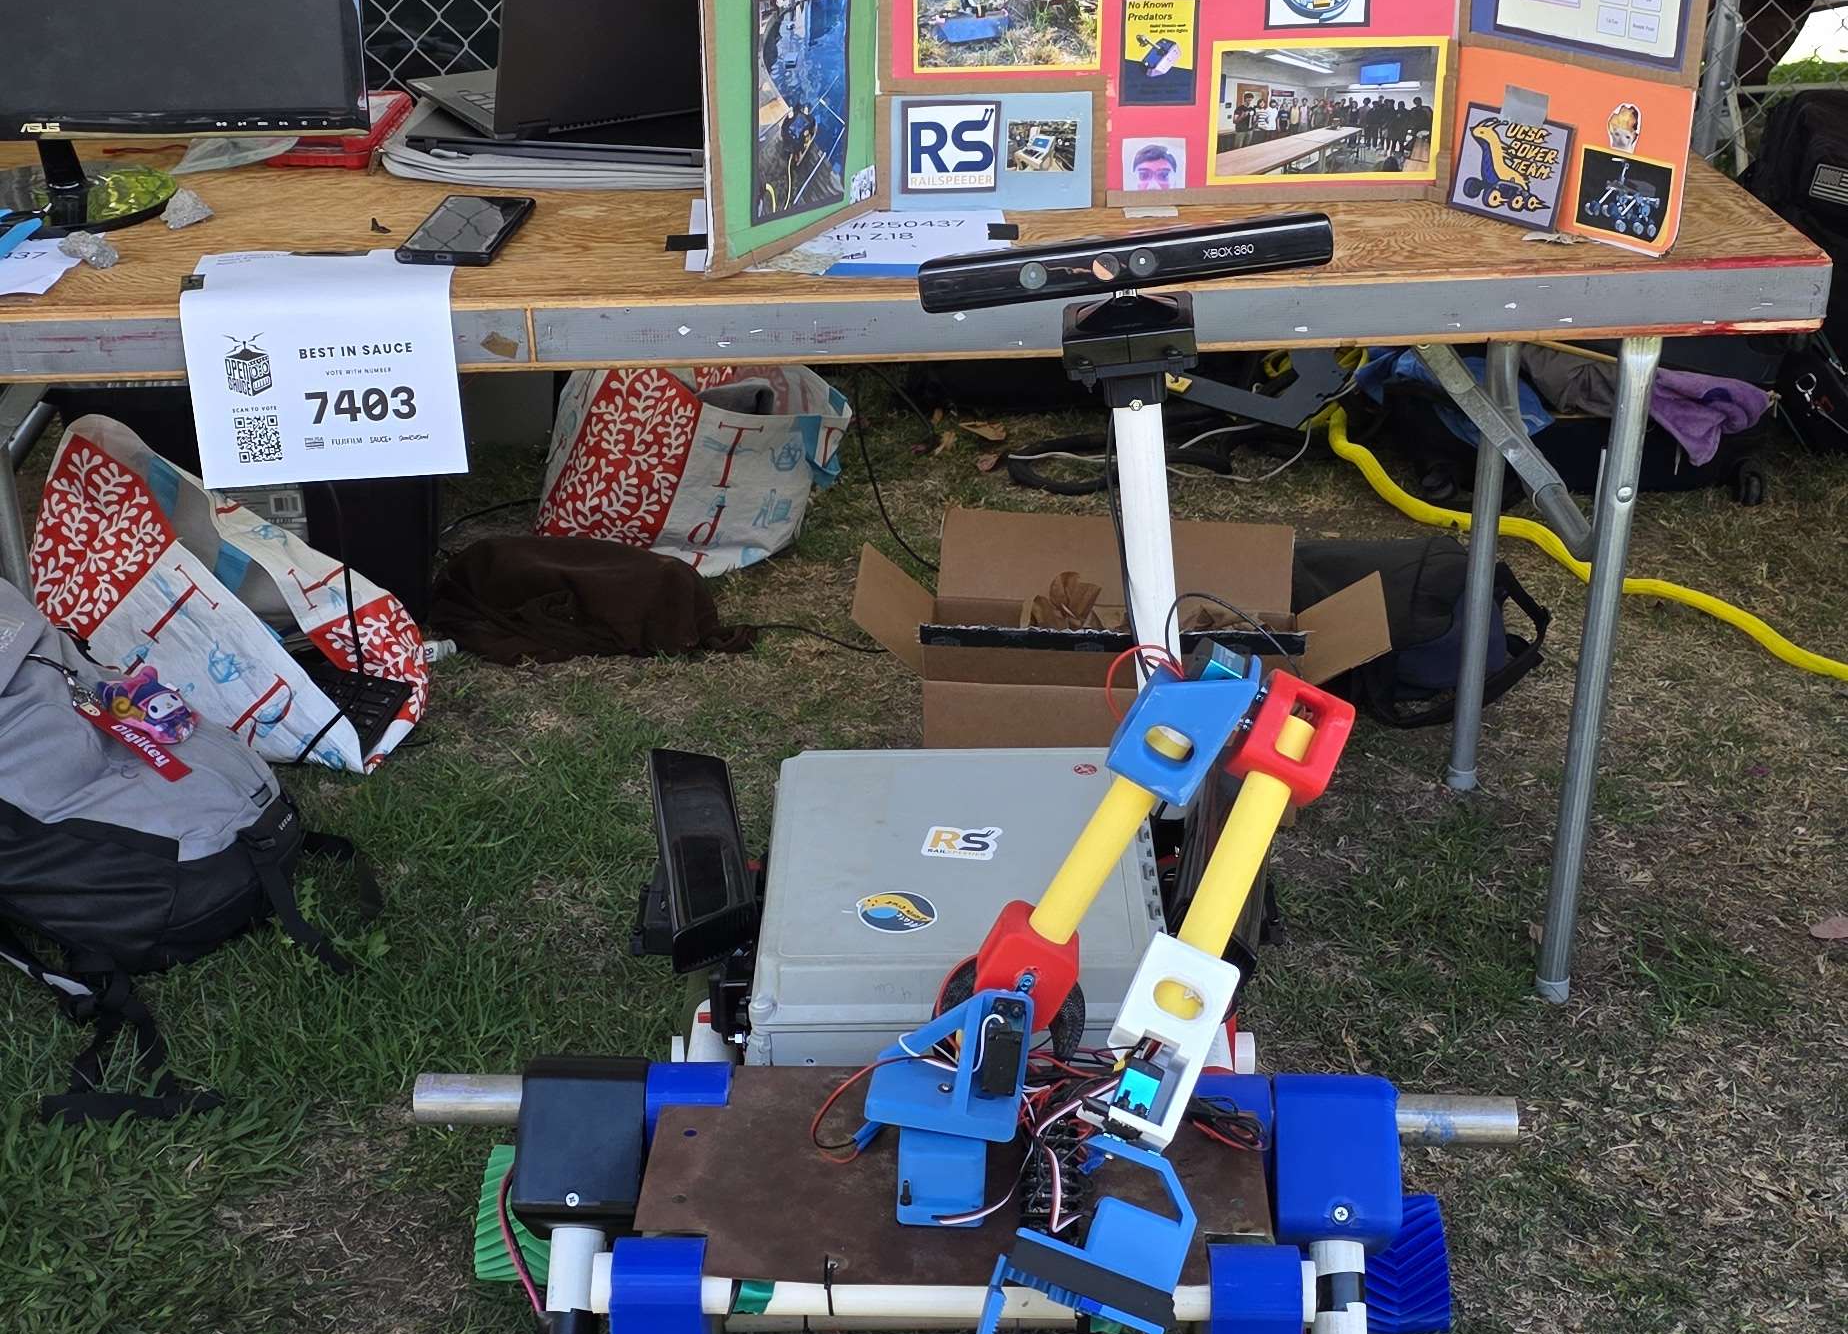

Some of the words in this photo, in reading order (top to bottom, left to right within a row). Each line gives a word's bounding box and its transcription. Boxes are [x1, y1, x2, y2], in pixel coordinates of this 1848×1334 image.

[1128, 13, 1173, 21] Predators
[21, 123, 60, 133] ASUS
[1506, 123, 1548, 143] UCSC
[910, 108, 994, 173] RS
[1508, 141, 1558, 164] ROVER
[1511, 158, 1551, 180] TEAM
[910, 175, 993, 187] RAILSPEEDER
[1203, 247, 1233, 259] XBOX
[1234, 243, 1255, 255] 360
[299, 346, 335, 359] BEST
[341, 345, 357, 357] IN
[362, 342, 413, 356] SAUCE
[225, 359, 249, 381] OPEN
[228, 377, 252, 396] SAUCE
[304, 386, 417, 424] 7403
[331, 437, 363, 445] FUJIFILM
[111, 722, 170, 767] DigiKey
[929, 830, 994, 852] RS
